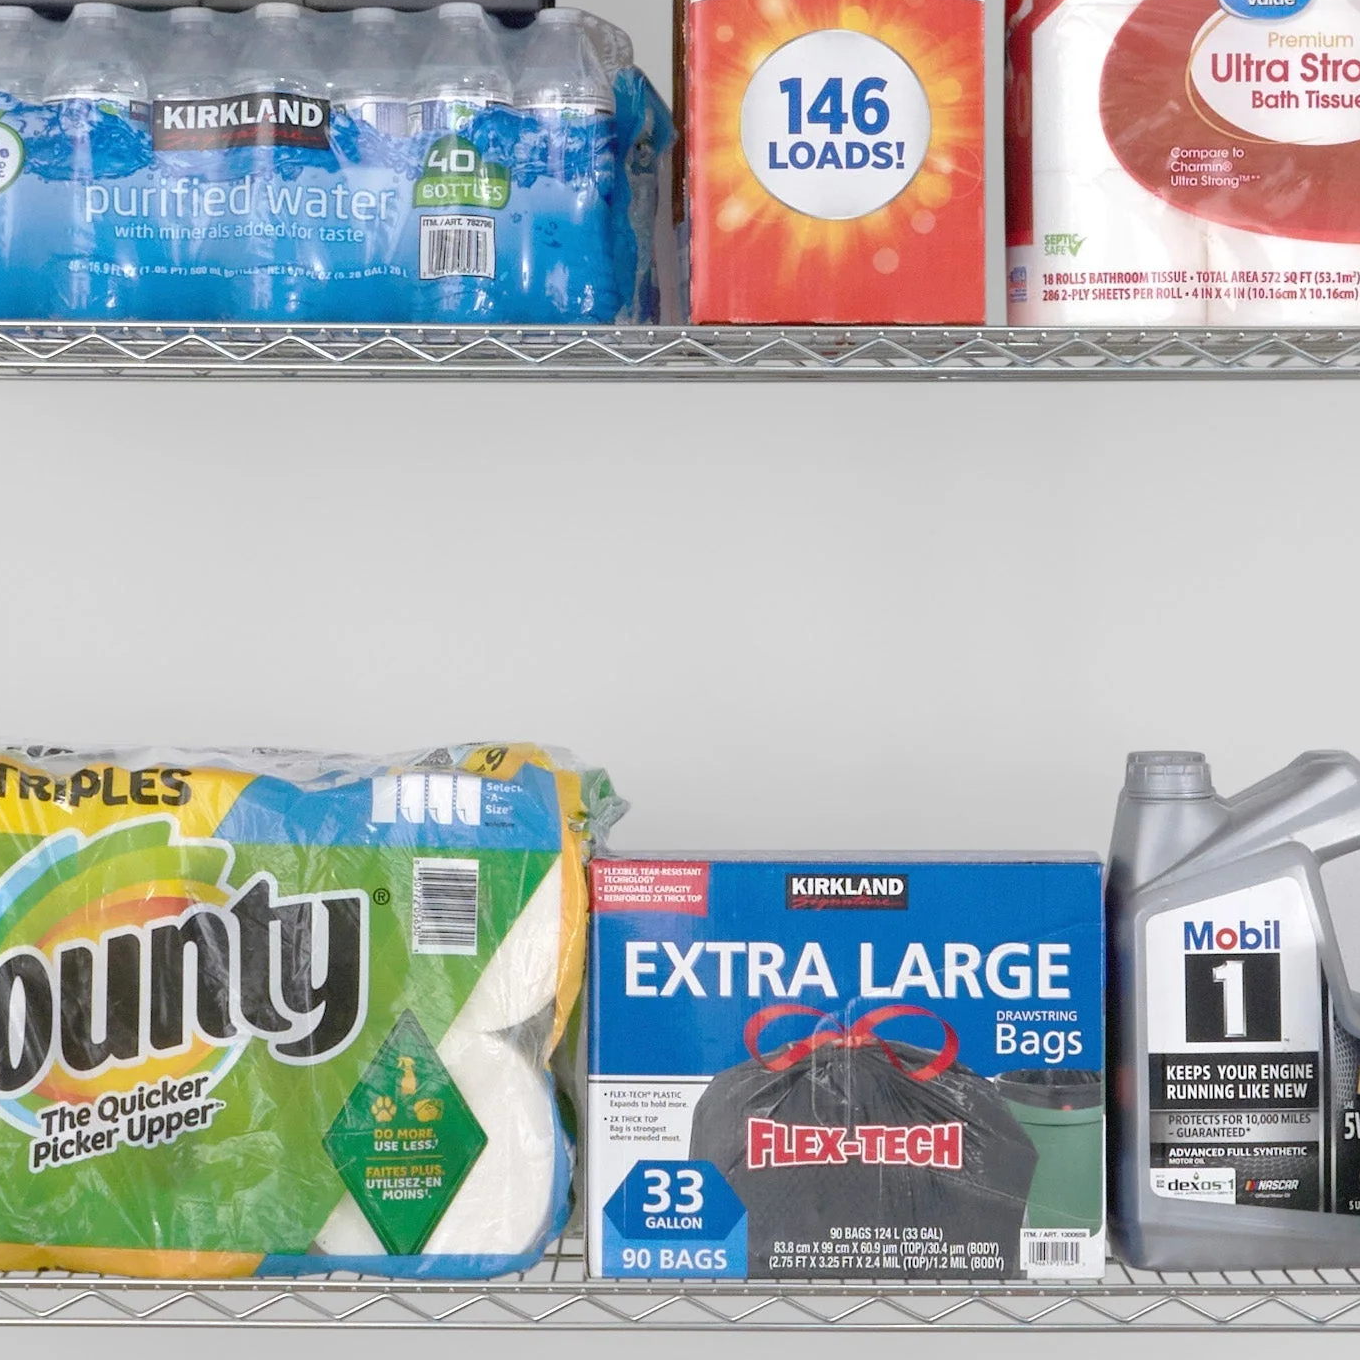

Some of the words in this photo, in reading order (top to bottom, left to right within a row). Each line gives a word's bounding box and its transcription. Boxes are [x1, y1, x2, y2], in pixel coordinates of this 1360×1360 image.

[1268, 31, 1354, 49] Premium
[1211, 53, 1291, 84] Ultra
[779, 77, 890, 135] 146
[1252, 90, 1300, 110] Bath
[163, 99, 323, 130] KIRKLAND
[428, 149, 474, 172] 40
[768, 141, 905, 170] LOADS!
[1171, 147, 1229, 160] Compare
[1233, 147, 1244, 158] to
[1171, 175, 1197, 186] Ultra
[86, 176, 250, 222] purified
[267, 183, 395, 220] water
[422, 183, 503, 202] BOTTLES
[115, 224, 153, 239] with
[159, 224, 230, 239] minerals
[235, 222, 286, 238] added
[291, 224, 313, 240] for
[318, 226, 364, 242] taste
[1044, 234, 1078, 245] SEPTIC
[1044, 245, 1066, 256] SAFE
[1043, 273, 1054, 286] 18
[1055, 273, 1087, 286] ROLLS
[1089, 272, 1149, 285] BATHROOM
[1152, 272, 1187, 284] TISSUE
[1197, 272, 1229, 284] TOTAL
[1232, 271, 1259, 283] AREA
[1283, 271, 1297, 285] SQ
[1300, 271, 1312, 283] FT
[1062, 289, 1090, 301] 2-PLY
[1092, 289, 1131, 300] SHEETS
[1133, 289, 1153, 300] PER
[1156, 288, 1182, 299] ROLL
[792, 878, 903, 896] KIRKLAND
[1184, 921, 1279, 950] Mobil
[624, 941, 837, 998] EXTRA
[860, 941, 1071, 999] LARGE
[1212, 960, 1248, 1038] 1
[996, 1010, 1077, 1022] DRAWSTRING
[996, 1024, 1082, 1062] Bags
[1166, 1065, 1210, 1080] KEEPS
[1218, 1064, 1257, 1080] YOUR
[1261, 1064, 1313, 1079] ENGINE
[1167, 1084, 1236, 1099] RUNNING
[1239, 1084, 1270, 1099] LIKE
[1274, 1083, 1308, 1098] NEW
[40, 1100, 91, 1135] The
[97, 1075, 208, 1125] Quicker
[1168, 1114, 1220, 1125] PROTECTS
[1223, 1114, 1243, 1125] FOR
[1245, 1114, 1278, 1126] 10,000
[1281, 1113, 1311, 1124] MILES
[374, 1129, 394, 1139] DO
[34, 1128, 119, 1167] Picker
[374, 1141, 399, 1151] USE
[747, 1118, 962, 1171] FLEX-TECH
[1168, 1147, 1225, 1158] ADVANCED
[1227, 1147, 1251, 1157] FULL
[1253, 1146, 1307, 1156] SYNTHETIC
[365, 1167, 407, 1177] FAITES
[366, 1178, 441, 1189] UTILISEZ-EN
[642, 1170, 704, 1214] 33
[1258, 1179, 1299, 1190] NASCAR
[646, 1217, 702, 1229] GALLON
[831, 1228, 842, 1239] 90
[845, 1228, 872, 1239] BAGS
[874, 1228, 891, 1239] 124
[903, 1228, 919, 1241] (33
[921, 1228, 943, 1241] GAL)
[967, 1242, 1000, 1256] (BODY)
[622, 1249, 650, 1269] 90
[660, 1249, 728, 1270] BAGS
[971, 1256, 1004, 1270] (BODY)
